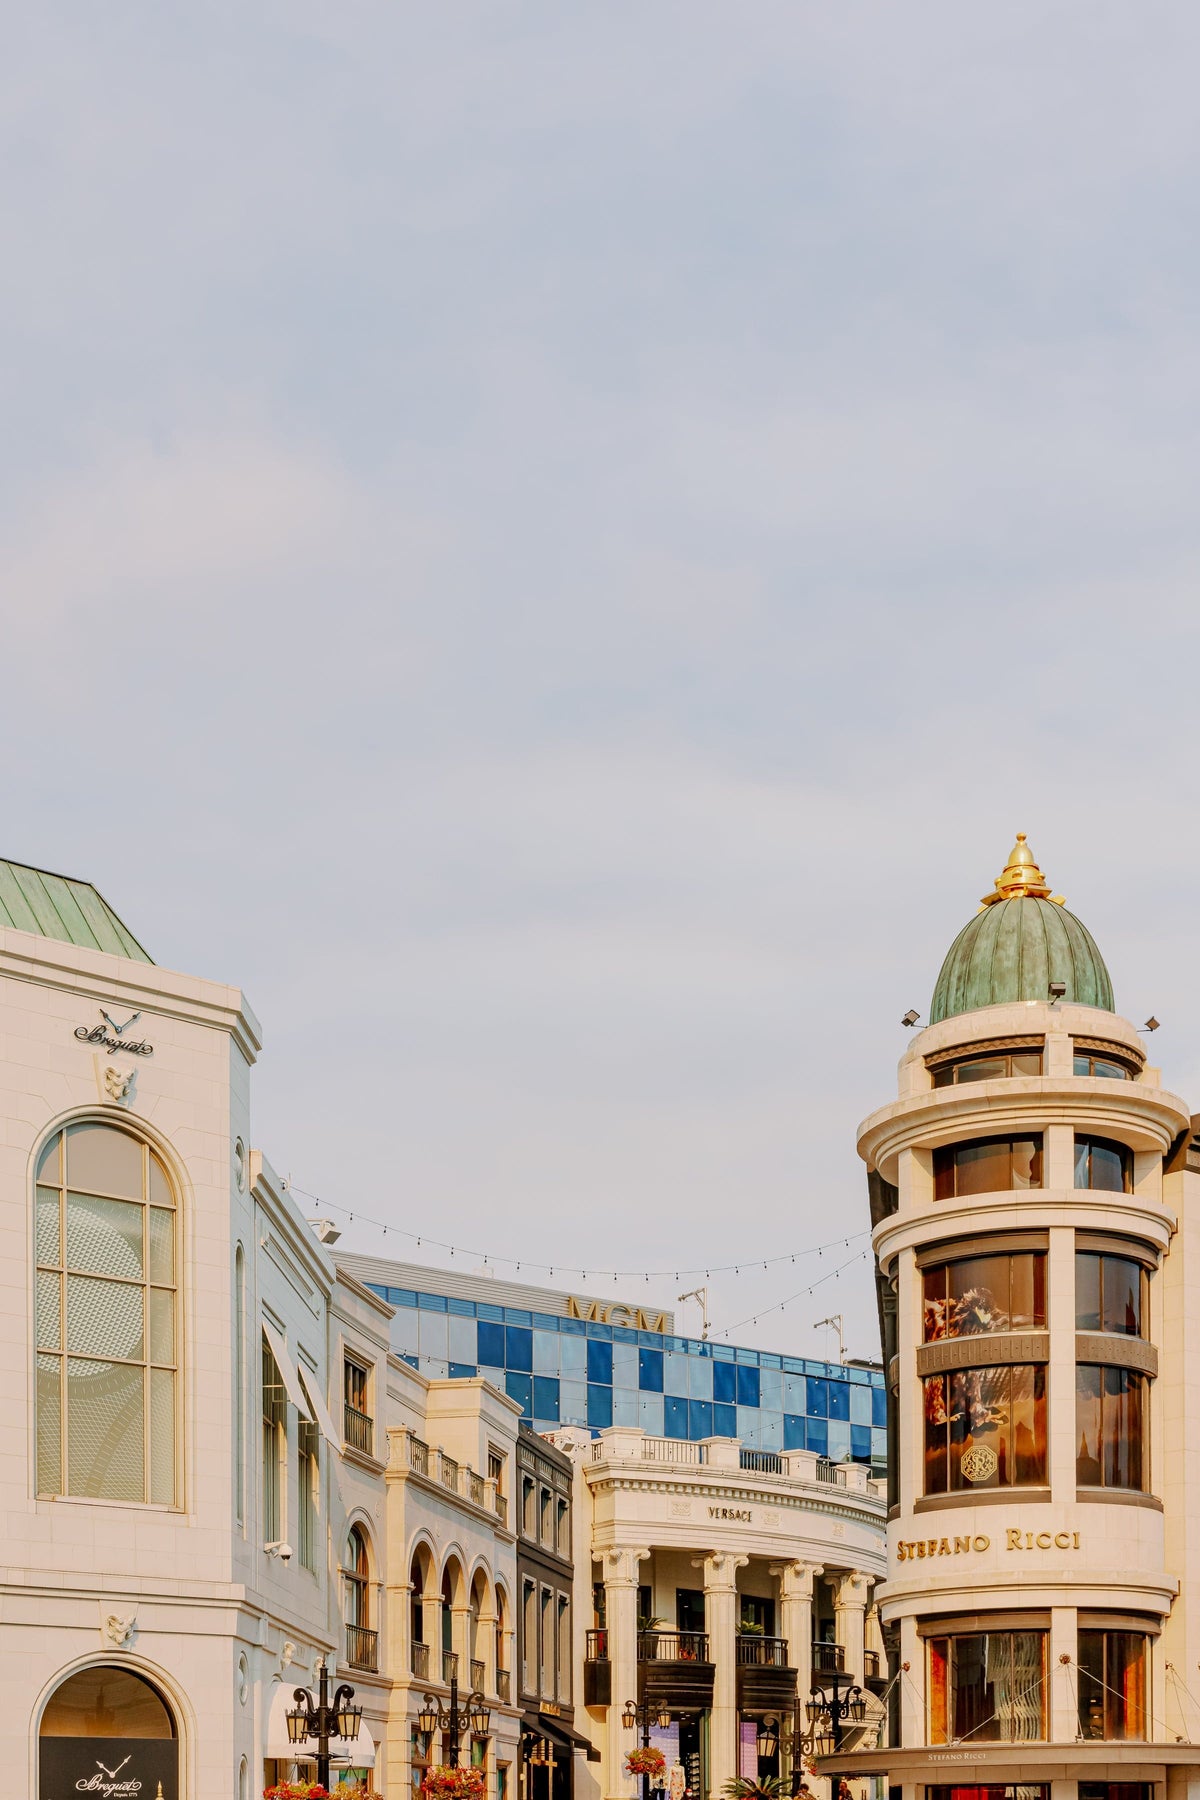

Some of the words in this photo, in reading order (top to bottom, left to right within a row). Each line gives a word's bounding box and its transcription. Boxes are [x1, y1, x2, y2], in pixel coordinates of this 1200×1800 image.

[74, 1025, 153, 1055] Breguet
[568, 1296, 668, 1334] MGM
[708, 1506, 753, 1523] VERSACE
[897, 1534, 990, 1562] STEFANO
[1006, 1527, 1081, 1551] RICCI
[928, 1753, 963, 1761] STEFANO
[963, 1752, 987, 1760] RICCI
[75, 1773, 142, 1798] Breguet
